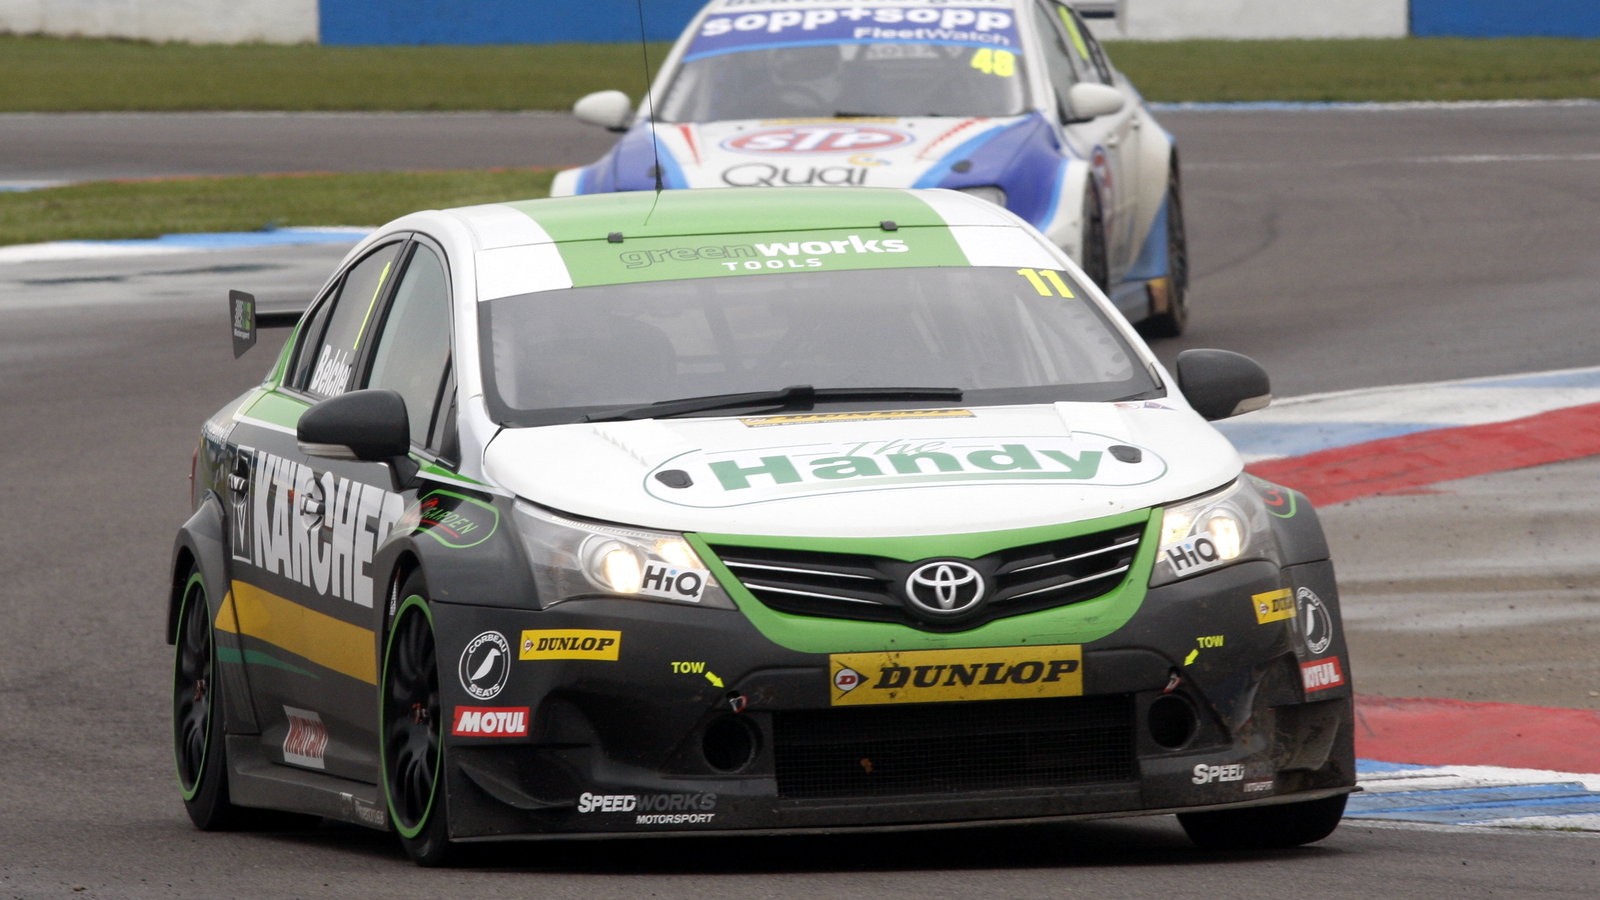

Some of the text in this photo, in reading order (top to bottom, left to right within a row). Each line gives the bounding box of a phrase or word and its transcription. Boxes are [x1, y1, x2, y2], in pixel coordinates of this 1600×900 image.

[702, 5, 1012, 36] sopp+sopp
[854, 27, 1010, 46] FleetWatch
[970, 47, 1016, 77] 48
[743, 127, 893, 151] STP
[619, 235, 909, 270] greenworks
[722, 257, 823, 271] TOOLS
[1016, 268, 1075, 299] 11
[842, 438, 946, 457] The
[708, 444, 1103, 491] Handy
[1166, 537, 1220, 571] HiQ
[642, 565, 701, 598] HiQ
[468, 633, 508, 654] CORBEAU
[536, 637, 615, 651] DUNLOP
[1196, 635, 1225, 648] TOW
[671, 661, 705, 674] TOW
[872, 660, 1080, 689] DUNLOP
[468, 683, 501, 697] SEATS
[456, 711, 526, 733] MOTUL
[635, 813, 716, 825] MOTORSPORT
